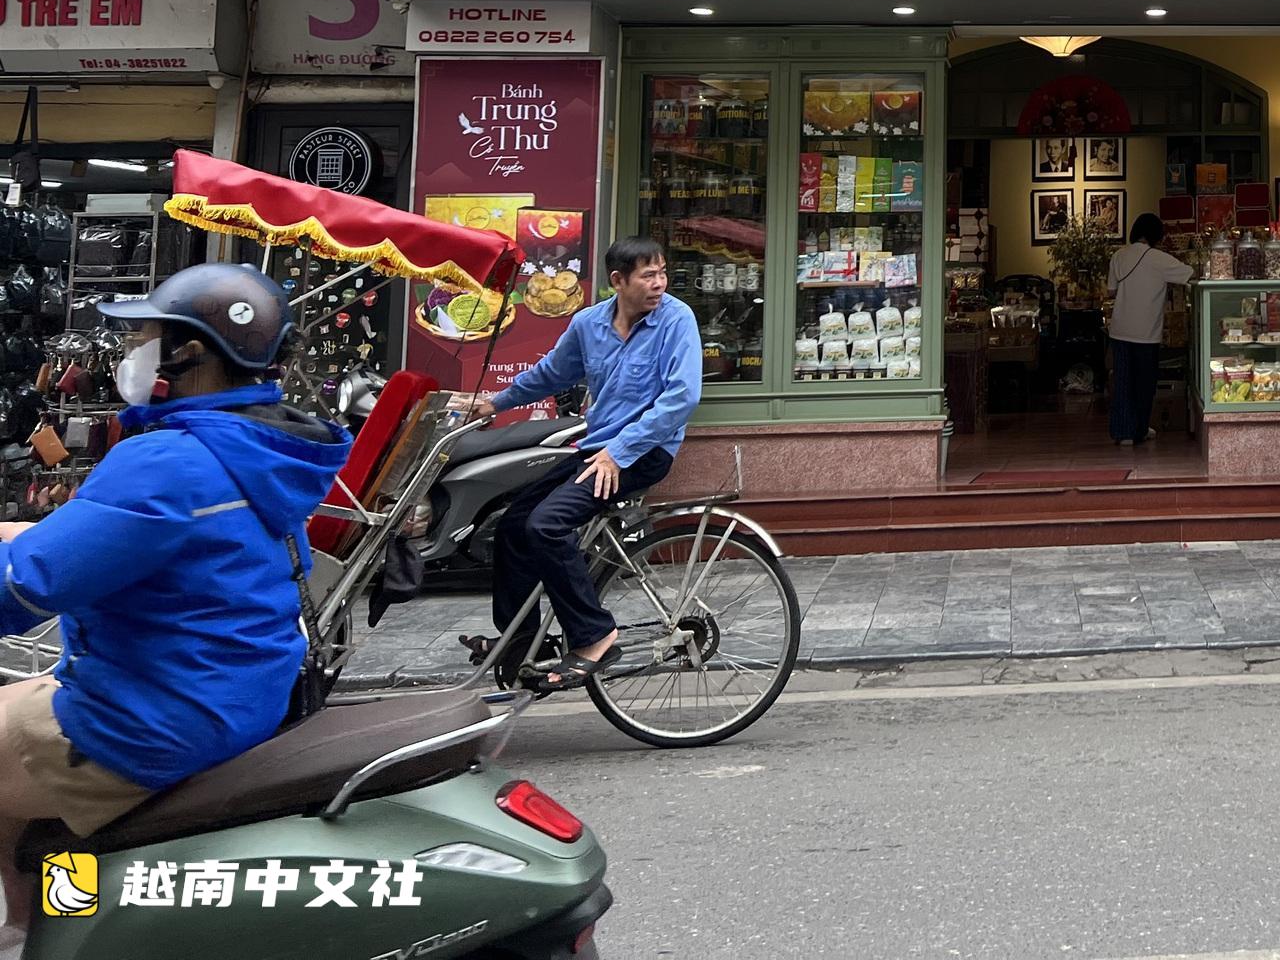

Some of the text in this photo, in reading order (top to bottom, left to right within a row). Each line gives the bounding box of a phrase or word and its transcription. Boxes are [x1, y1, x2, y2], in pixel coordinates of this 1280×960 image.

[448, 8, 546, 21] HOTLINE
[418, 29, 576, 44] 0822 260 754
[501, 83, 544, 99] Bánh
[472, 95, 558, 132] Trung
[298, 134, 362, 159] PASTEUR STREET
[491, 125, 549, 150] Thu
